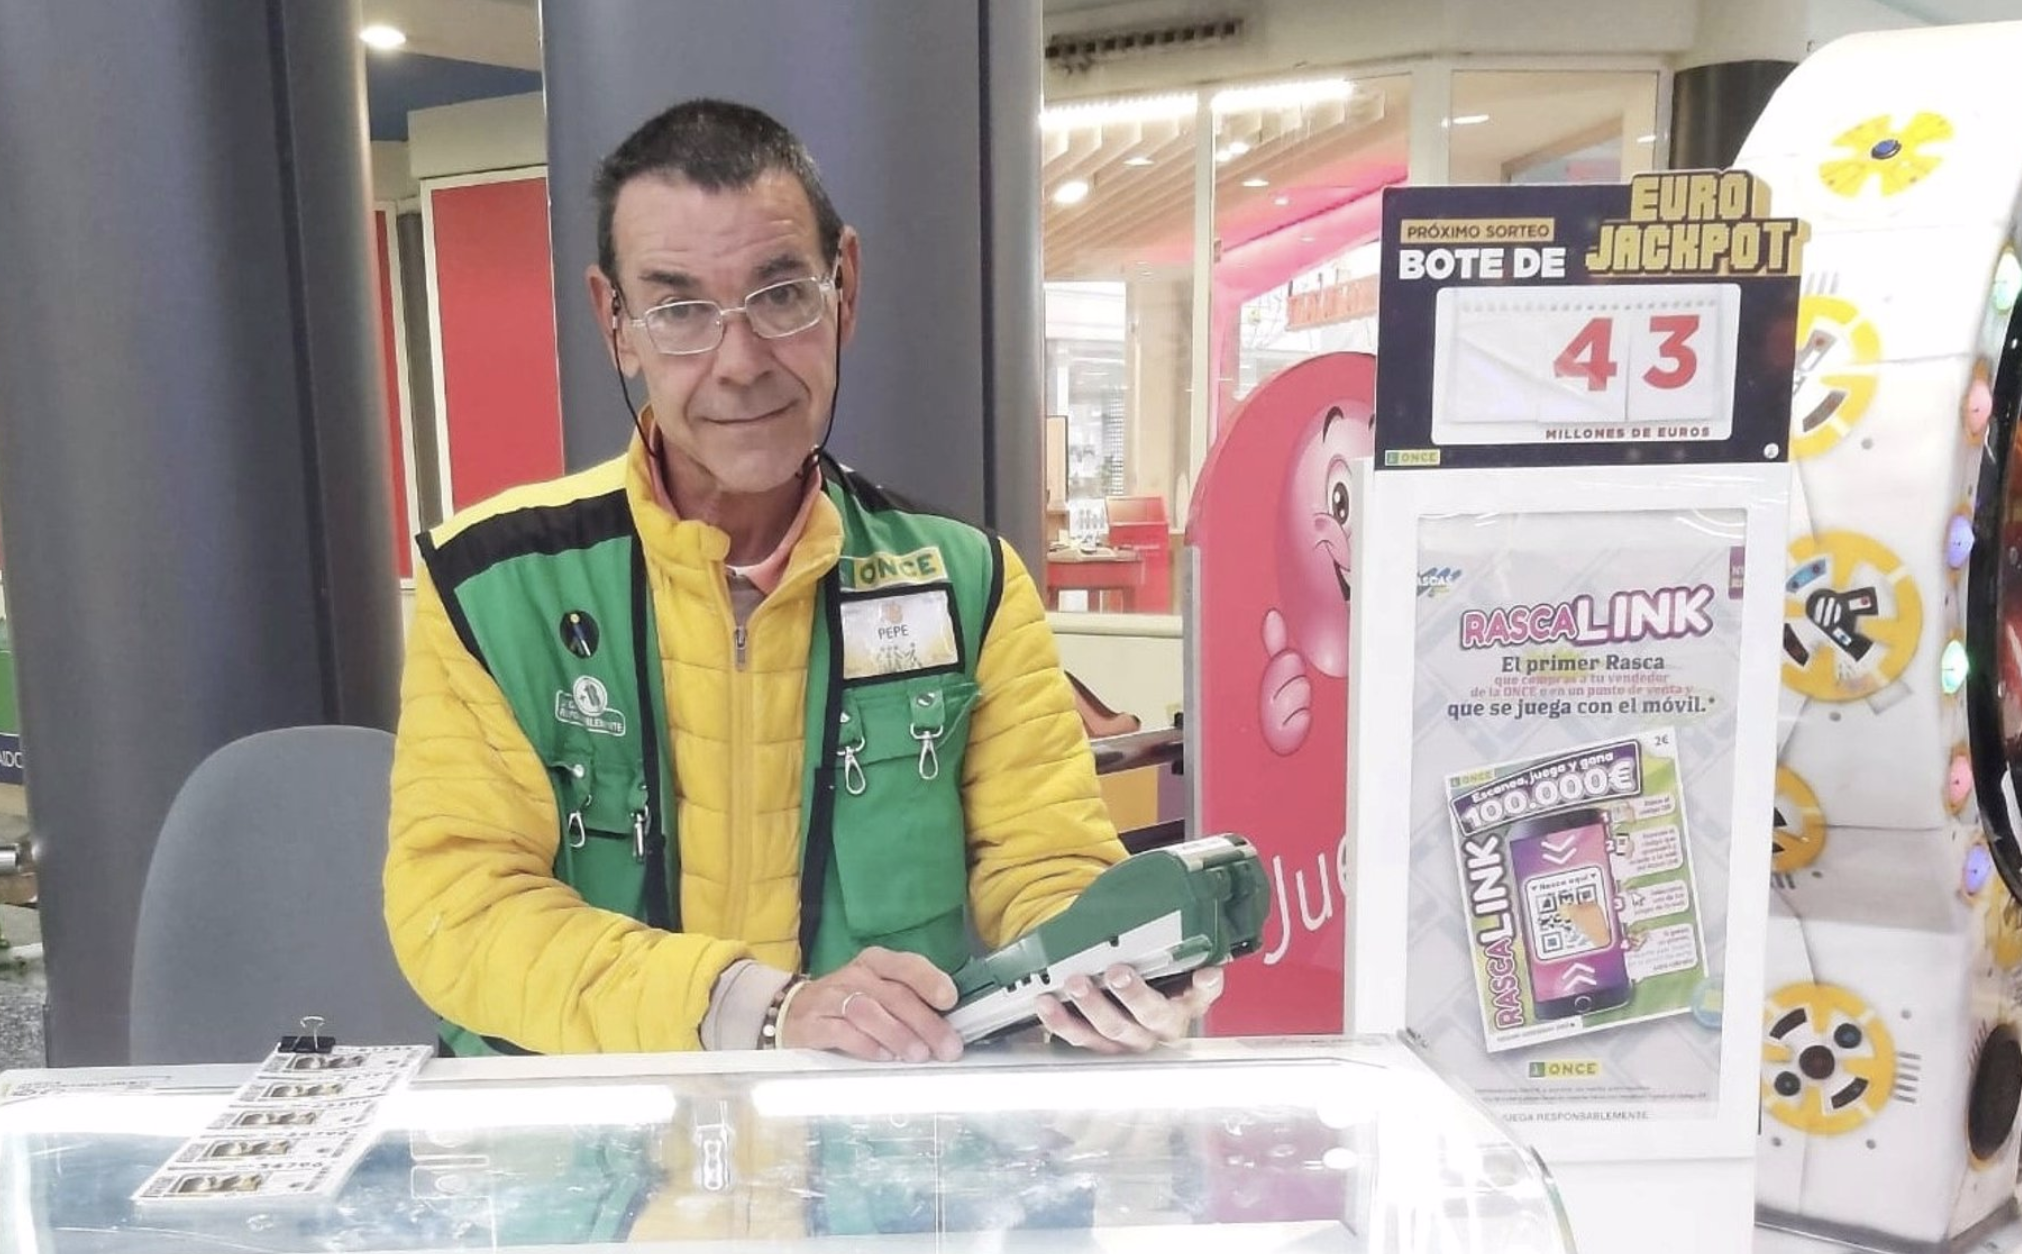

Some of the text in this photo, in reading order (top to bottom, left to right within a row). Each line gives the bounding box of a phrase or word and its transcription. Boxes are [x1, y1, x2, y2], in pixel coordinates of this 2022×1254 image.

[1631, 173, 1750, 221] EURO
[1407, 223, 1550, 240] PRÓXIMO SORTEO
[1585, 220, 1793, 274] JACKPOT
[1399, 246, 1567, 279] BOTE DE
[1545, 426, 1711, 440] MILLONES DE EUROS
[1401, 452, 1439, 464] ONCE
[860, 553, 937, 584] ONCE
[878, 624, 910, 640] PEPE
[1501, 654, 1665, 674] El primer Rasca
[1494, 675, 1519, 686] que
[1521, 675, 1578, 686] compras
[1590, 673, 1604, 684] tu
[1608, 672, 1669, 683] vendedor
[1471, 686, 1486, 697] de
[1489, 686, 1501, 697] la
[1503, 686, 1537, 697] ONCE
[1549, 687, 1566, 696] en
[1568, 687, 1585, 696] un
[1587, 685, 1624, 698] punto
[1628, 684, 1643, 695] de
[1647, 685, 1683, 696] venta
[1447, 702, 1485, 720] que
[1489, 702, 1512, 716] se
[1516, 698, 1571, 719] juega
[1577, 700, 1613, 715] con
[1618, 697, 1637, 714] el
[1654, 735, 1670, 747] 2€
[1461, 770, 1492, 784] ONCE
[1472, 775, 1528, 803] Escanea,
[1530, 764, 1566, 787] juega
[1580, 751, 1615, 768] gana
[1461, 759, 1634, 829] 100.000€
[1548, 1062, 1599, 1075] ONCE
[1536, 1110, 1649, 1122] RESPONSABLEMENTE
